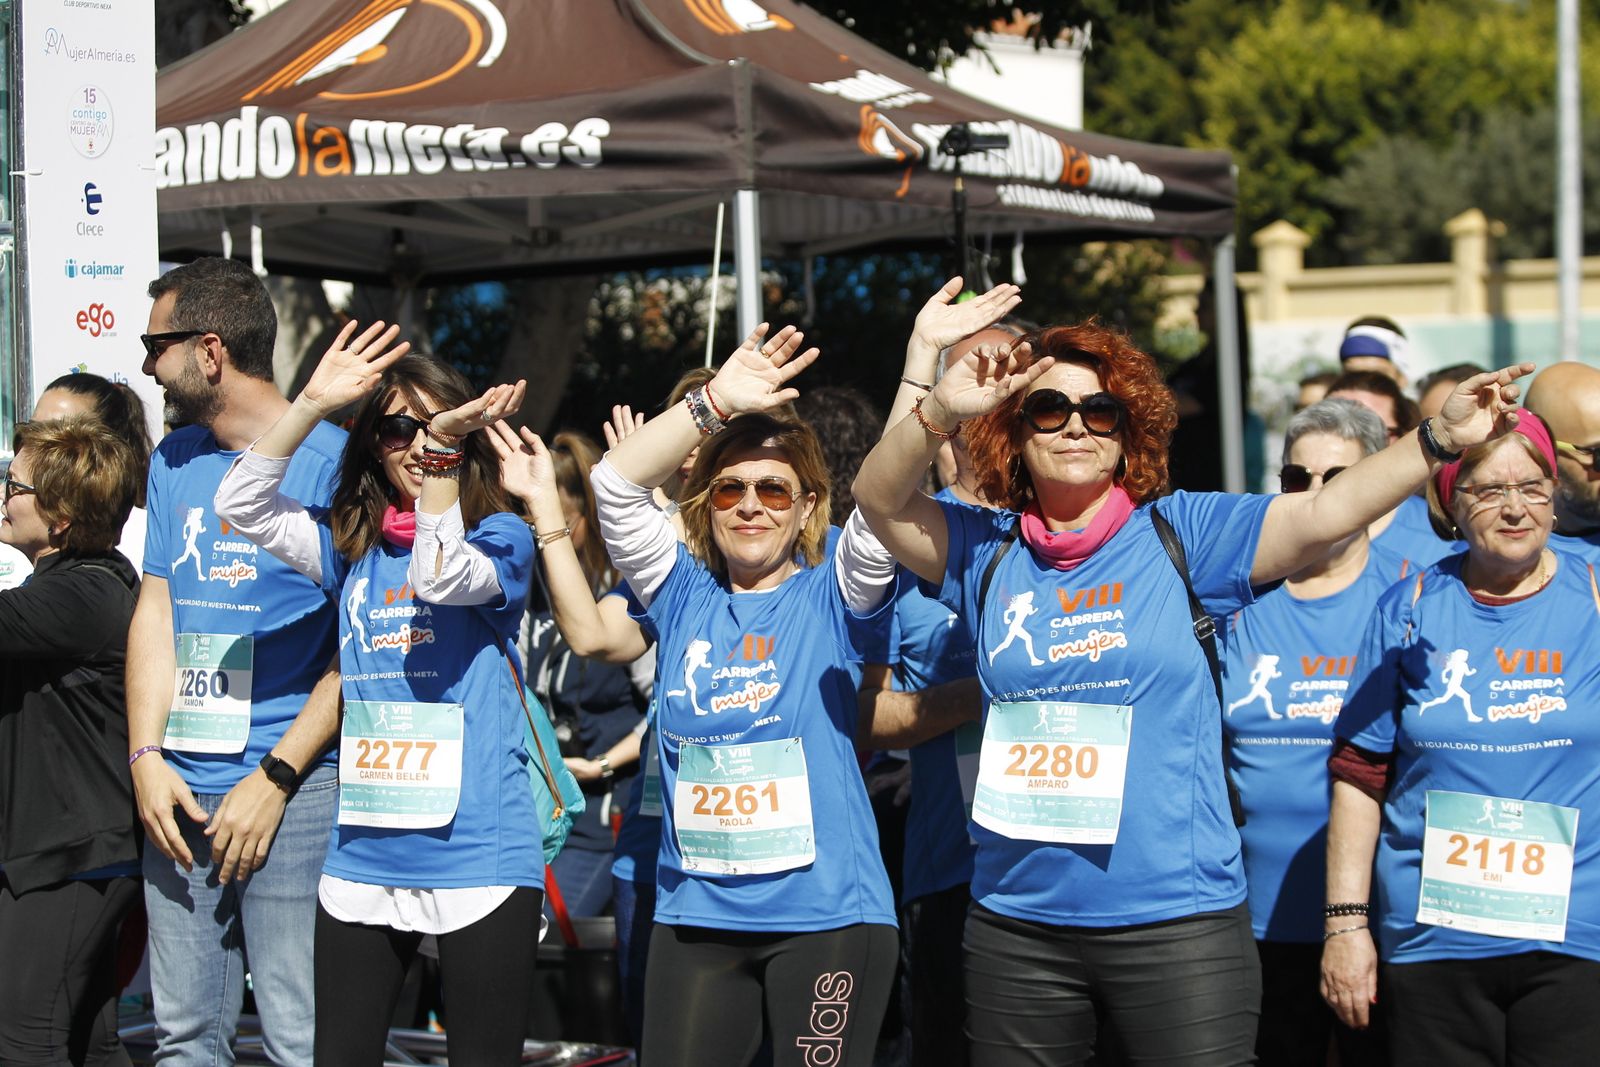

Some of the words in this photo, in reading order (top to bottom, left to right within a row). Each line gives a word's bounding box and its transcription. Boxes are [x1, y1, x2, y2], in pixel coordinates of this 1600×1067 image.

[83, 88, 97, 104] 15
[72, 108, 107, 121] contigo
[70, 126, 96, 136] MUJER
[76, 221, 104, 236] Clece
[81, 261, 125, 279] cajamar
[76, 303, 115, 338] ego
[213, 541, 258, 555] CARRERA
[1056, 582, 1124, 614] VIII
[238, 604, 262, 612] META
[369, 606, 433, 620] CARRERA
[1050, 609, 1124, 629] CARRERA
[1051, 628, 1075, 639] DE
[1100, 621, 1124, 632] LA
[1494, 647, 1563, 675] VIII
[179, 669, 229, 699] 2260
[1061, 681, 1104, 692] NUESTRA
[1105, 678, 1132, 688] META
[1290, 680, 1349, 692] CARRER
[1489, 677, 1565, 691] CARRERA
[1490, 691, 1515, 700] DE
[184, 698, 204, 708] RAMON
[391, 705, 412, 715] VIII
[1055, 706, 1078, 717] VIII
[756, 714, 782, 727] META
[728, 746, 752, 758] VIII
[1425, 742, 1479, 751] IGUALDAD
[1481, 744, 1494, 752] ES
[1496, 743, 1542, 753] NUESTRA
[1544, 738, 1573, 747] META
[355, 739, 437, 771] 2277
[1004, 744, 1099, 779] 2280
[360, 770, 393, 780] CARMEN
[396, 772, 430, 781] BELEN
[1027, 779, 1069, 789] AMPARO
[692, 781, 779, 816] 2261
[719, 816, 753, 827] PAOLA
[1446, 834, 1545, 876] 2118
[1483, 871, 1502, 883] EMI
